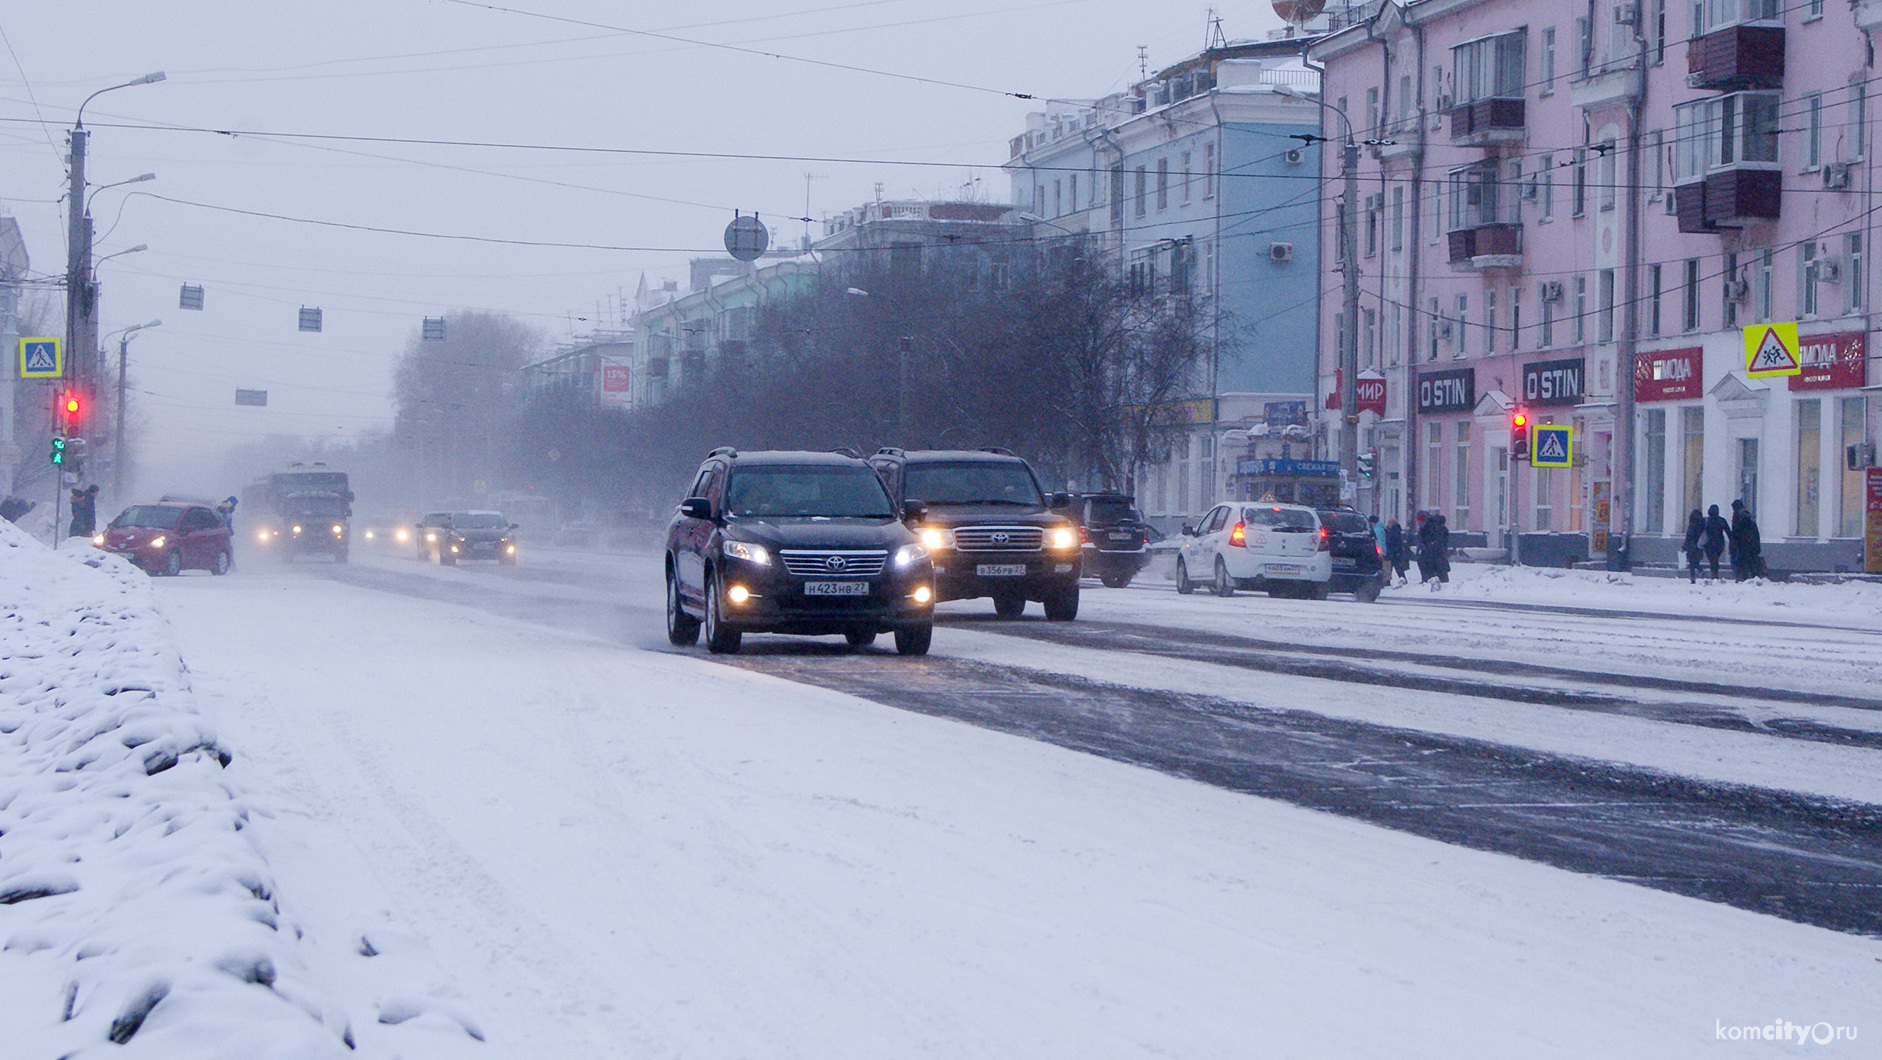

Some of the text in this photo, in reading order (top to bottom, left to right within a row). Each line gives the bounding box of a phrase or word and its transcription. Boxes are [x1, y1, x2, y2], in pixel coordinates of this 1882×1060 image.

[1661, 358, 1692, 381] МОДА
[808, 583, 866, 594] Н423НВ 27
